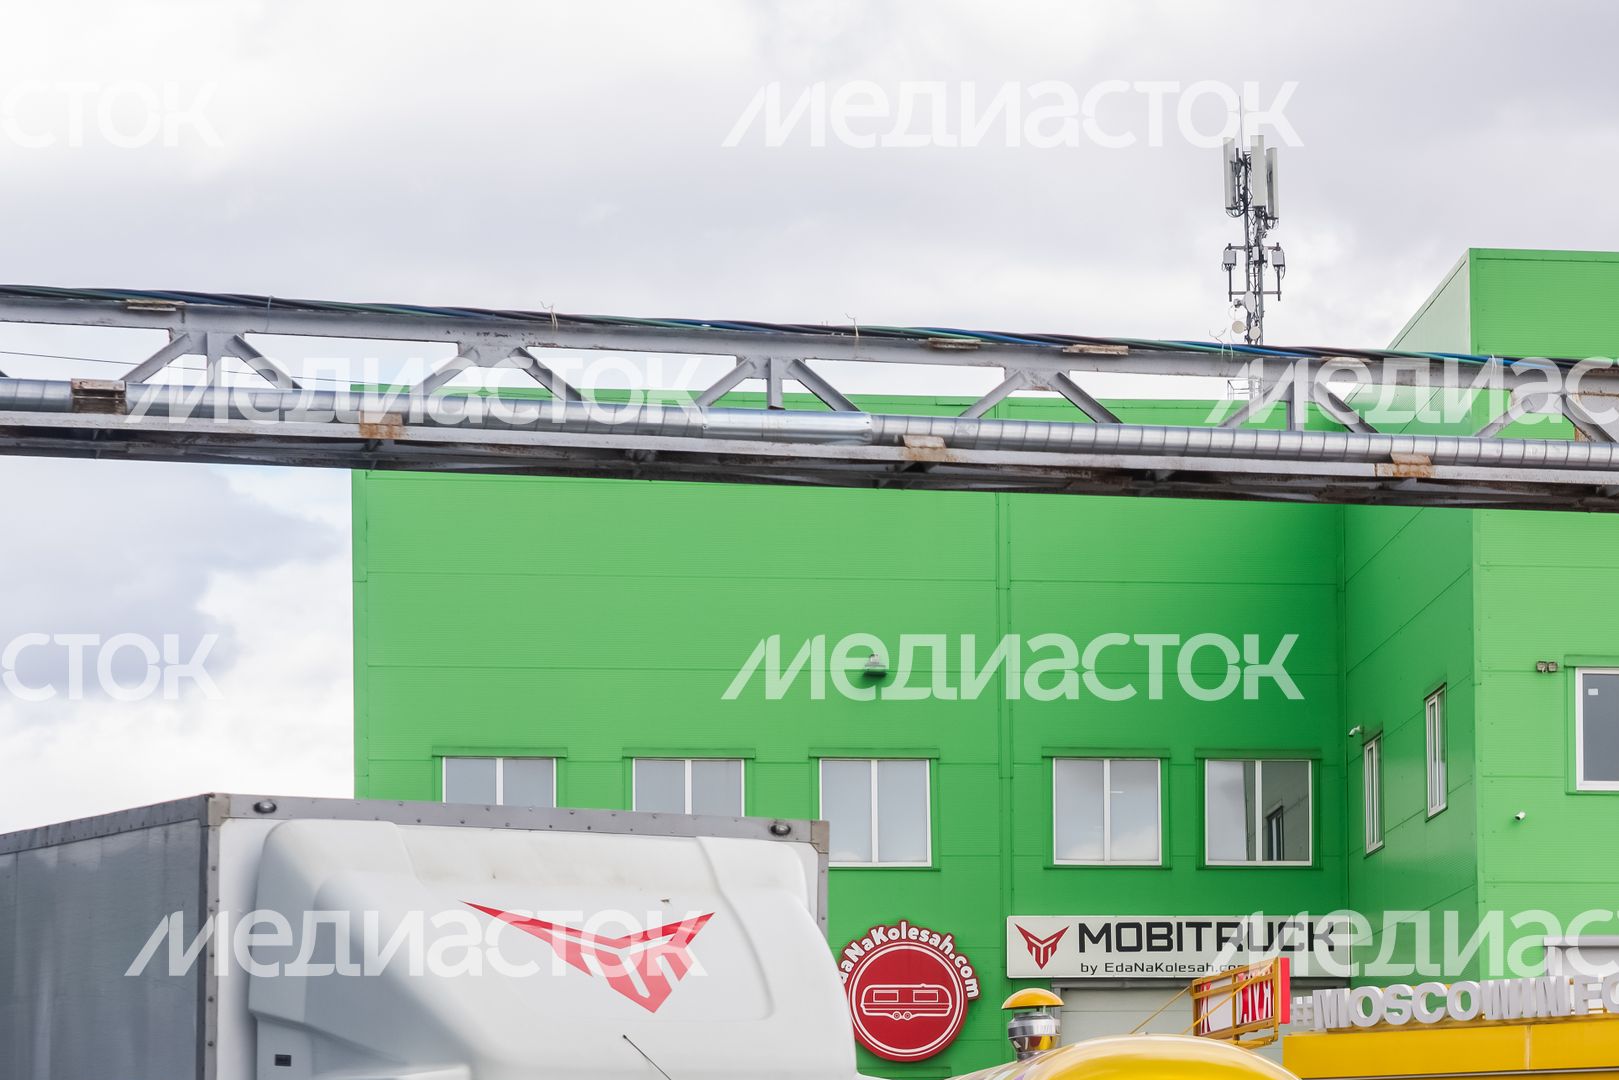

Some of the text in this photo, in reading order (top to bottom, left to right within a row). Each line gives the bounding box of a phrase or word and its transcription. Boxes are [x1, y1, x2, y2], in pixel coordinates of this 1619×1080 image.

[1078, 921, 1335, 953] MOBITRUCK
[1080, 962, 1246, 975] by EdaNaKolesah.co
